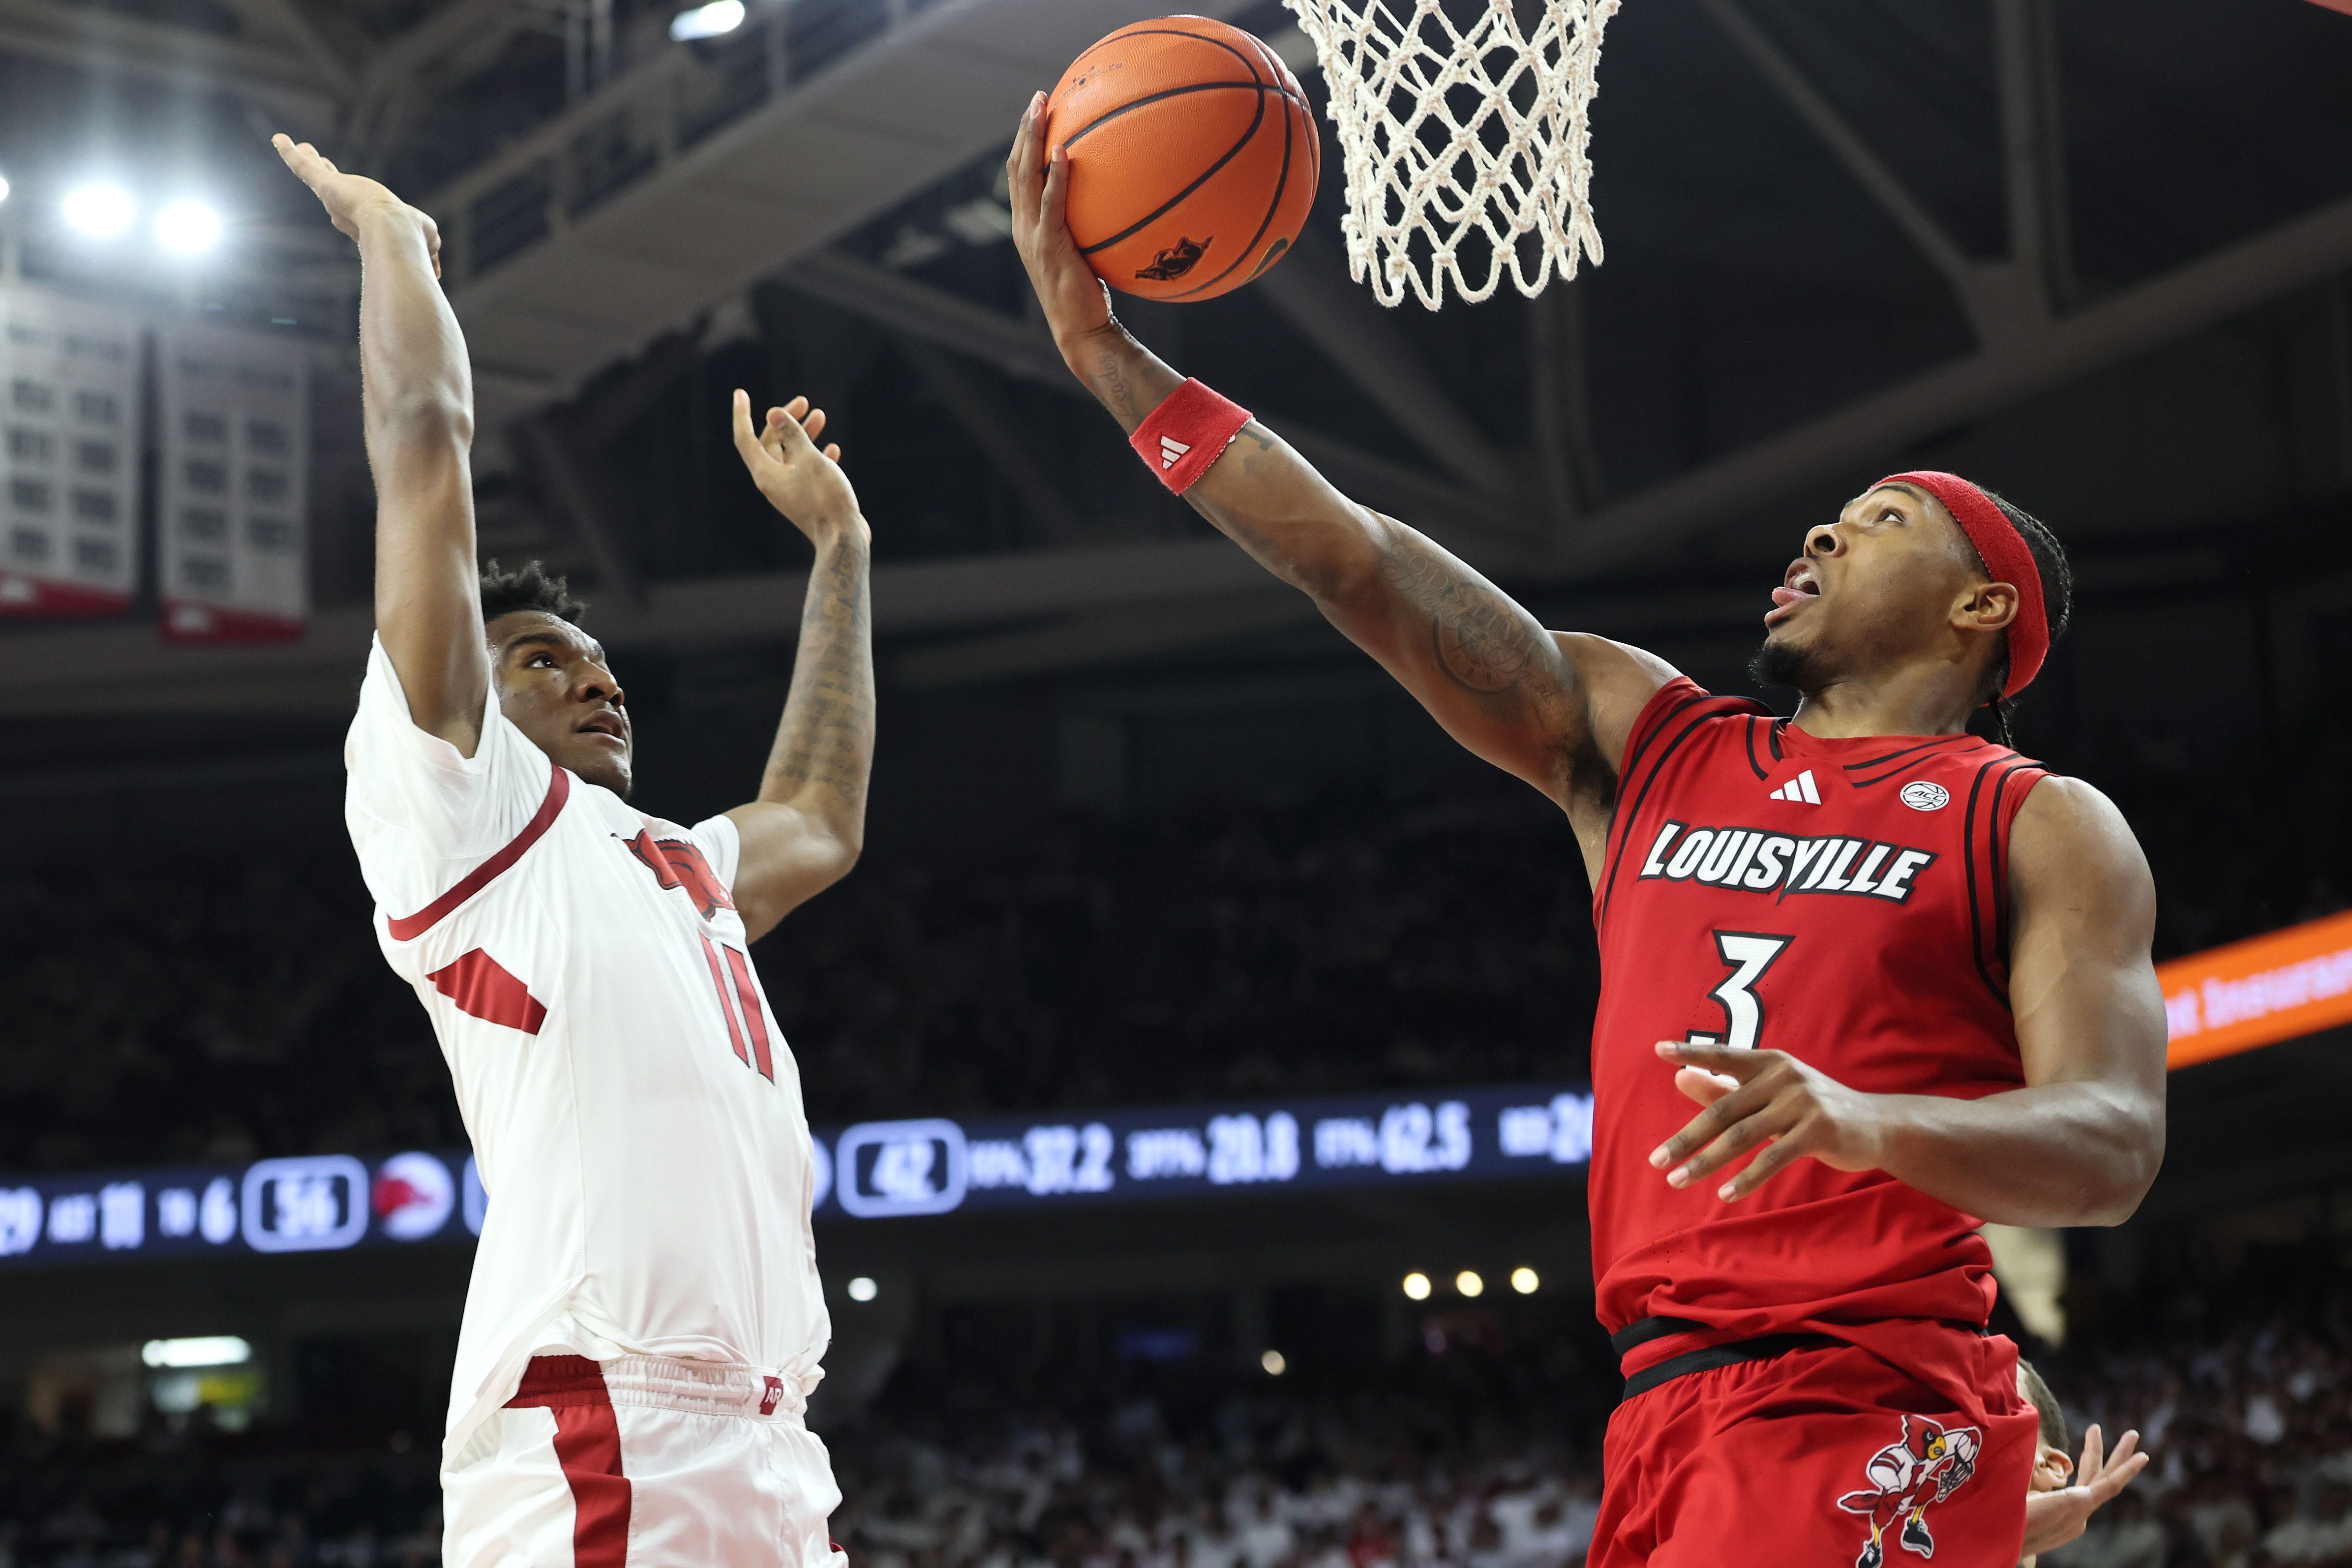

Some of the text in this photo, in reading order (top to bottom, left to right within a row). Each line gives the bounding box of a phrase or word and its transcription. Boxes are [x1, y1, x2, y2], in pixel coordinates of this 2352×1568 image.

[1908, 790, 1946, 802] ACC
[1639, 819, 1938, 905] LOUISVILLE
[698, 929, 775, 1086] 11
[1682, 930, 1794, 1087] 3
[765, 1387, 784, 1404] AR
